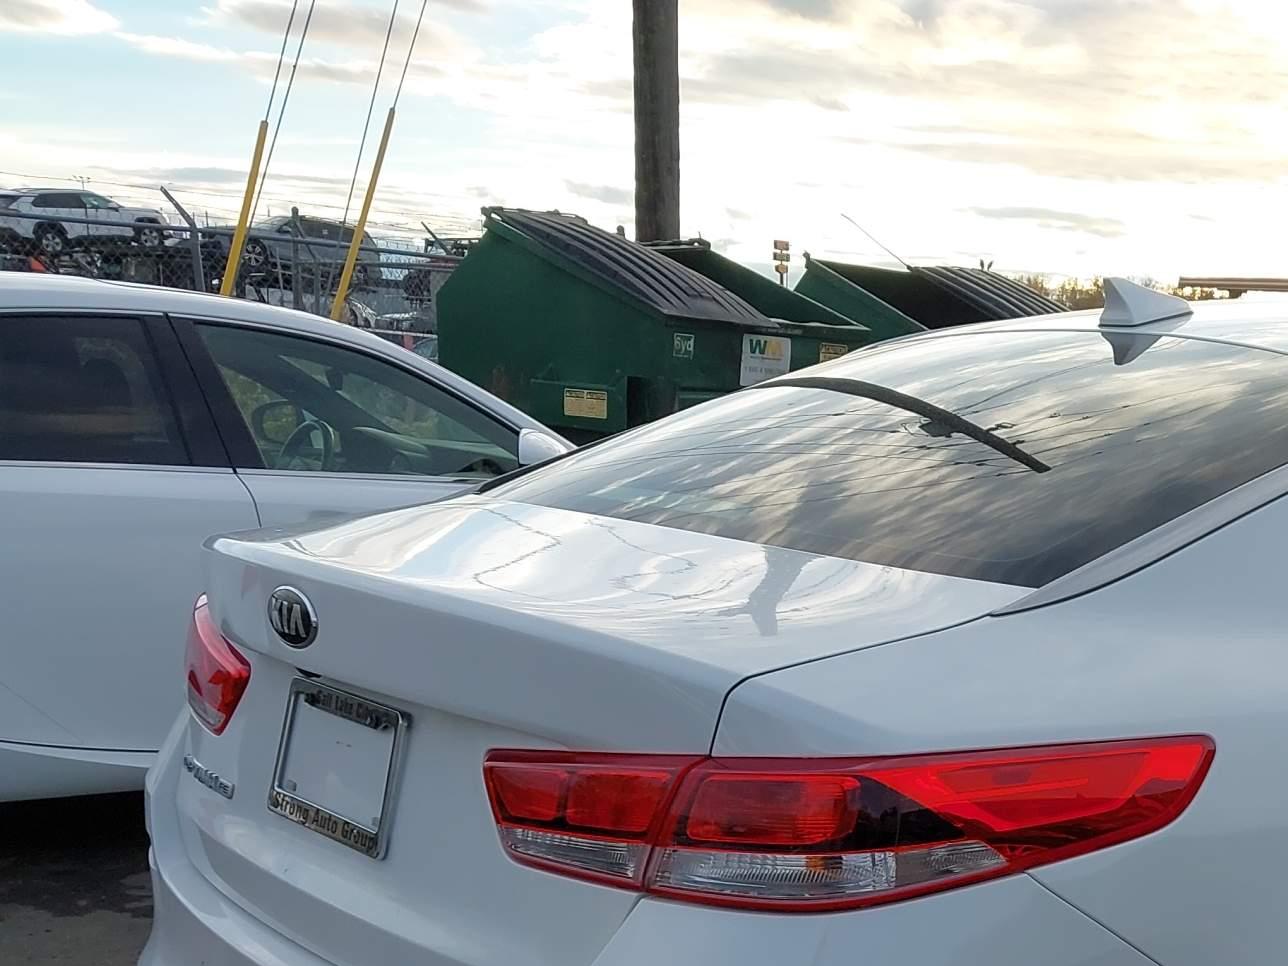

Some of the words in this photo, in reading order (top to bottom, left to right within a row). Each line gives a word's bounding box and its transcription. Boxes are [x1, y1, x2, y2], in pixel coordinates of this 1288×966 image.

[749, 338, 784, 356] WM
[271, 595, 307, 638] KIA
[272, 791, 310, 823] Strong
[312, 808, 337, 834] Auto
[341, 821, 378, 854] Group
